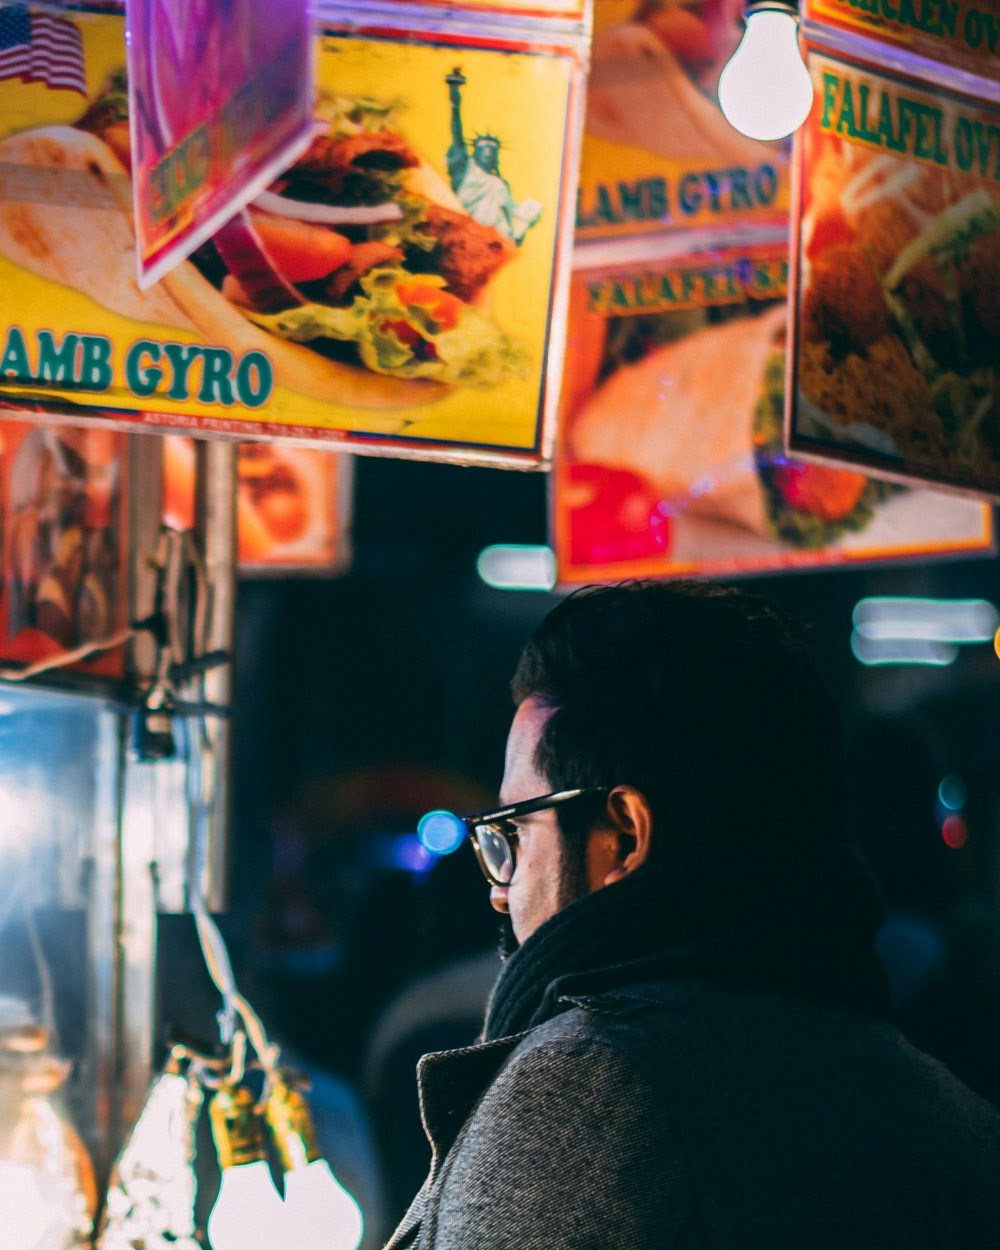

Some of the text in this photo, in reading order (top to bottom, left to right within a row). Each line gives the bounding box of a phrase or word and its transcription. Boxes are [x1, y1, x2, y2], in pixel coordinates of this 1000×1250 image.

[822, 73, 948, 165] FALAFEL
[679, 163, 777, 215] GYRO
[125, 339, 274, 409] GYRO
